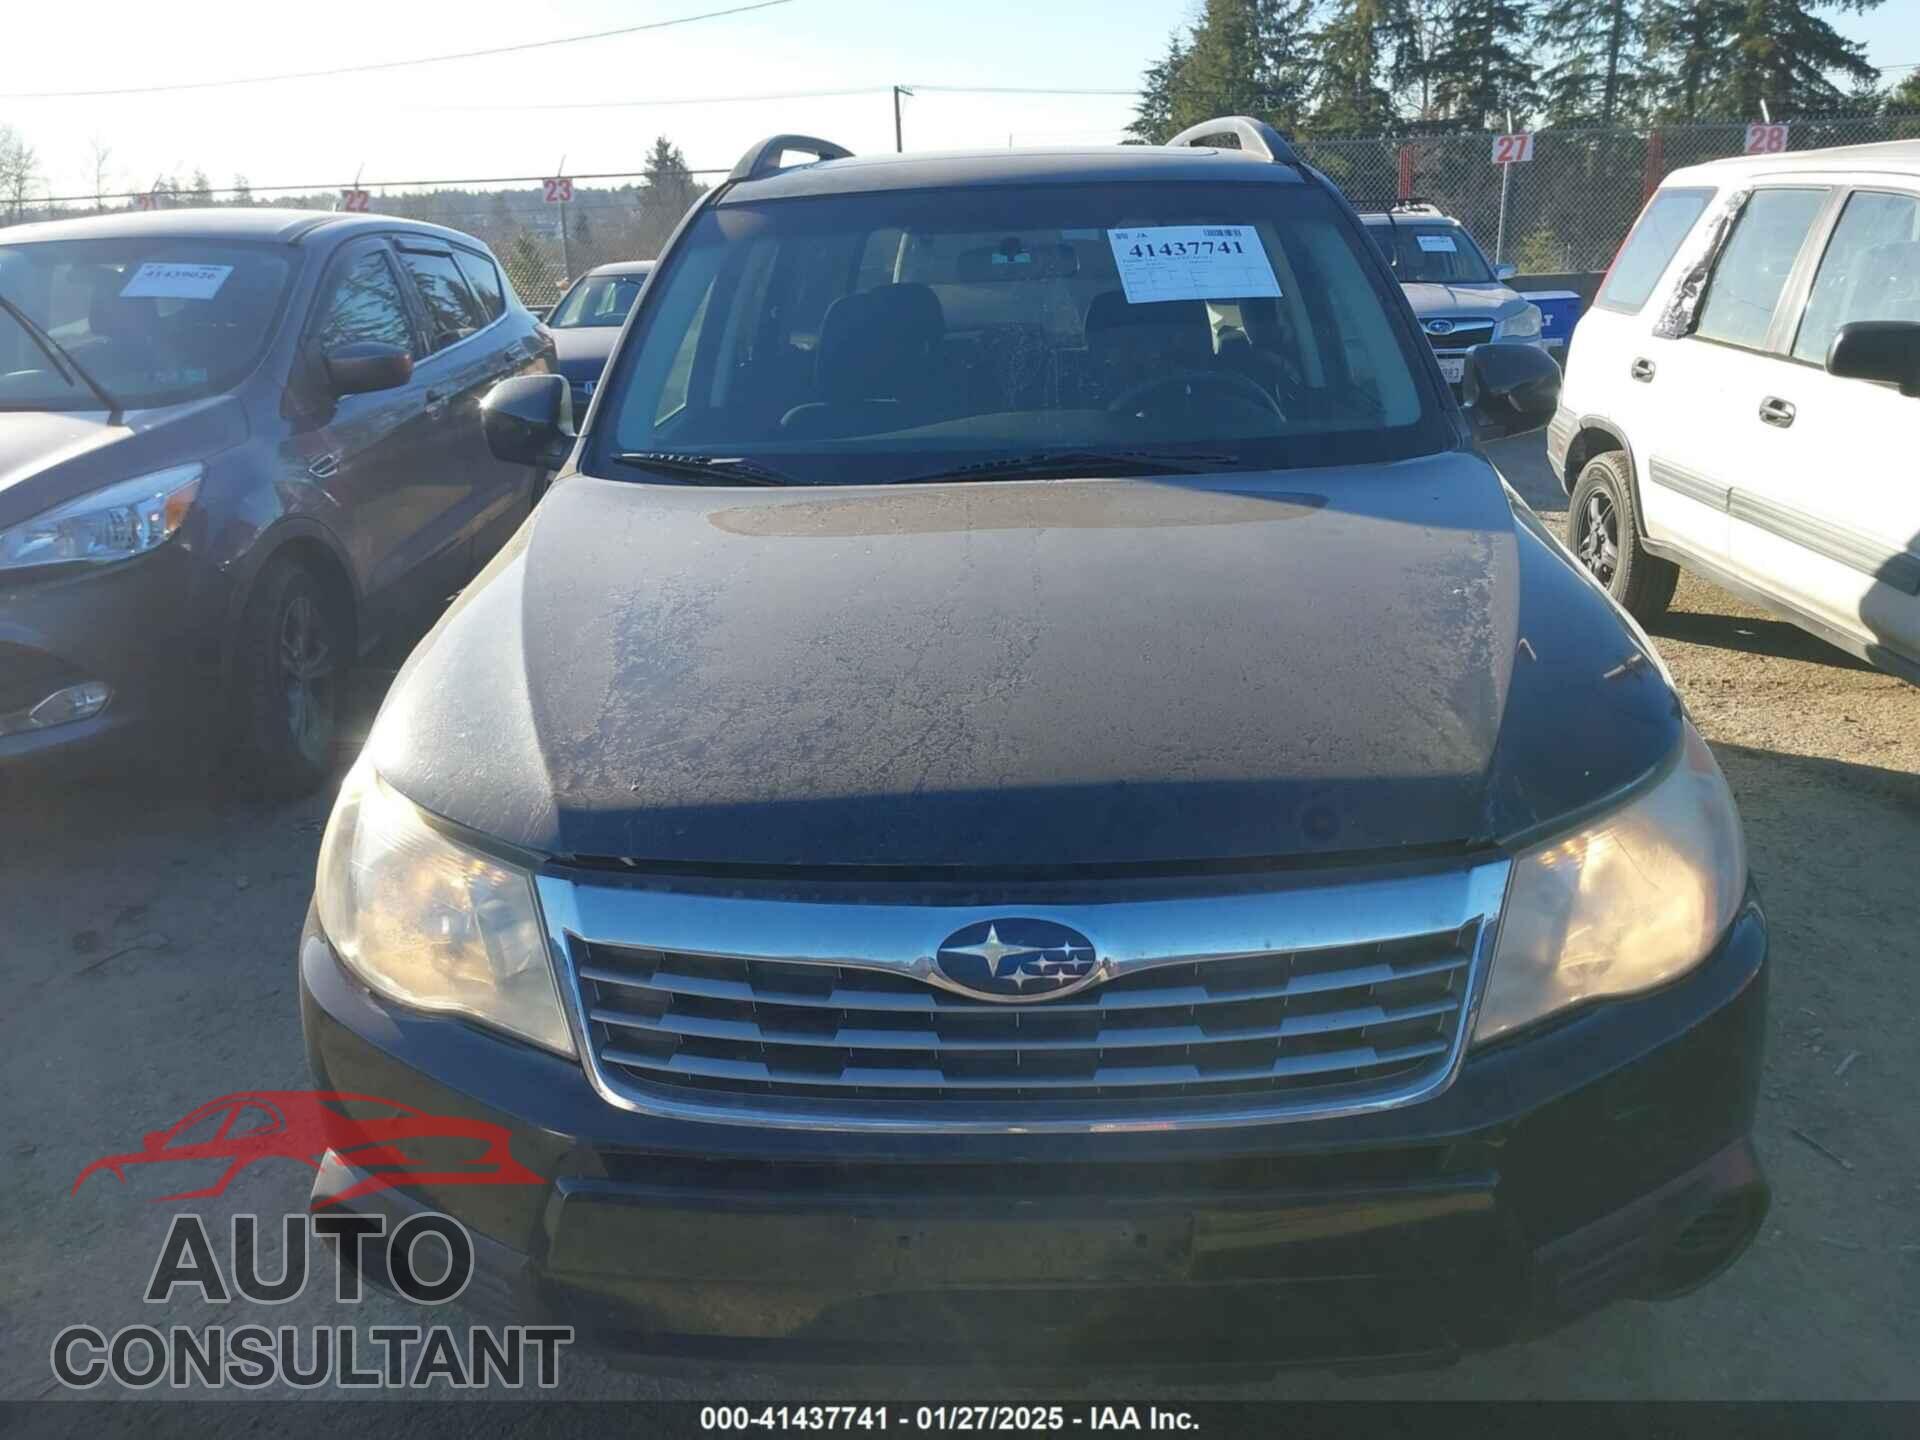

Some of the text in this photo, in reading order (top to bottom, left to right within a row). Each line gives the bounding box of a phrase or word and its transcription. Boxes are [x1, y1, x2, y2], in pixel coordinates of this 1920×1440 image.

[1497, 136, 1528, 161] 27
[1751, 127, 1784, 152] 28
[342, 190, 369, 213] 22
[545, 180, 571, 201] 23
[1129, 241, 1246, 257] 41437741
